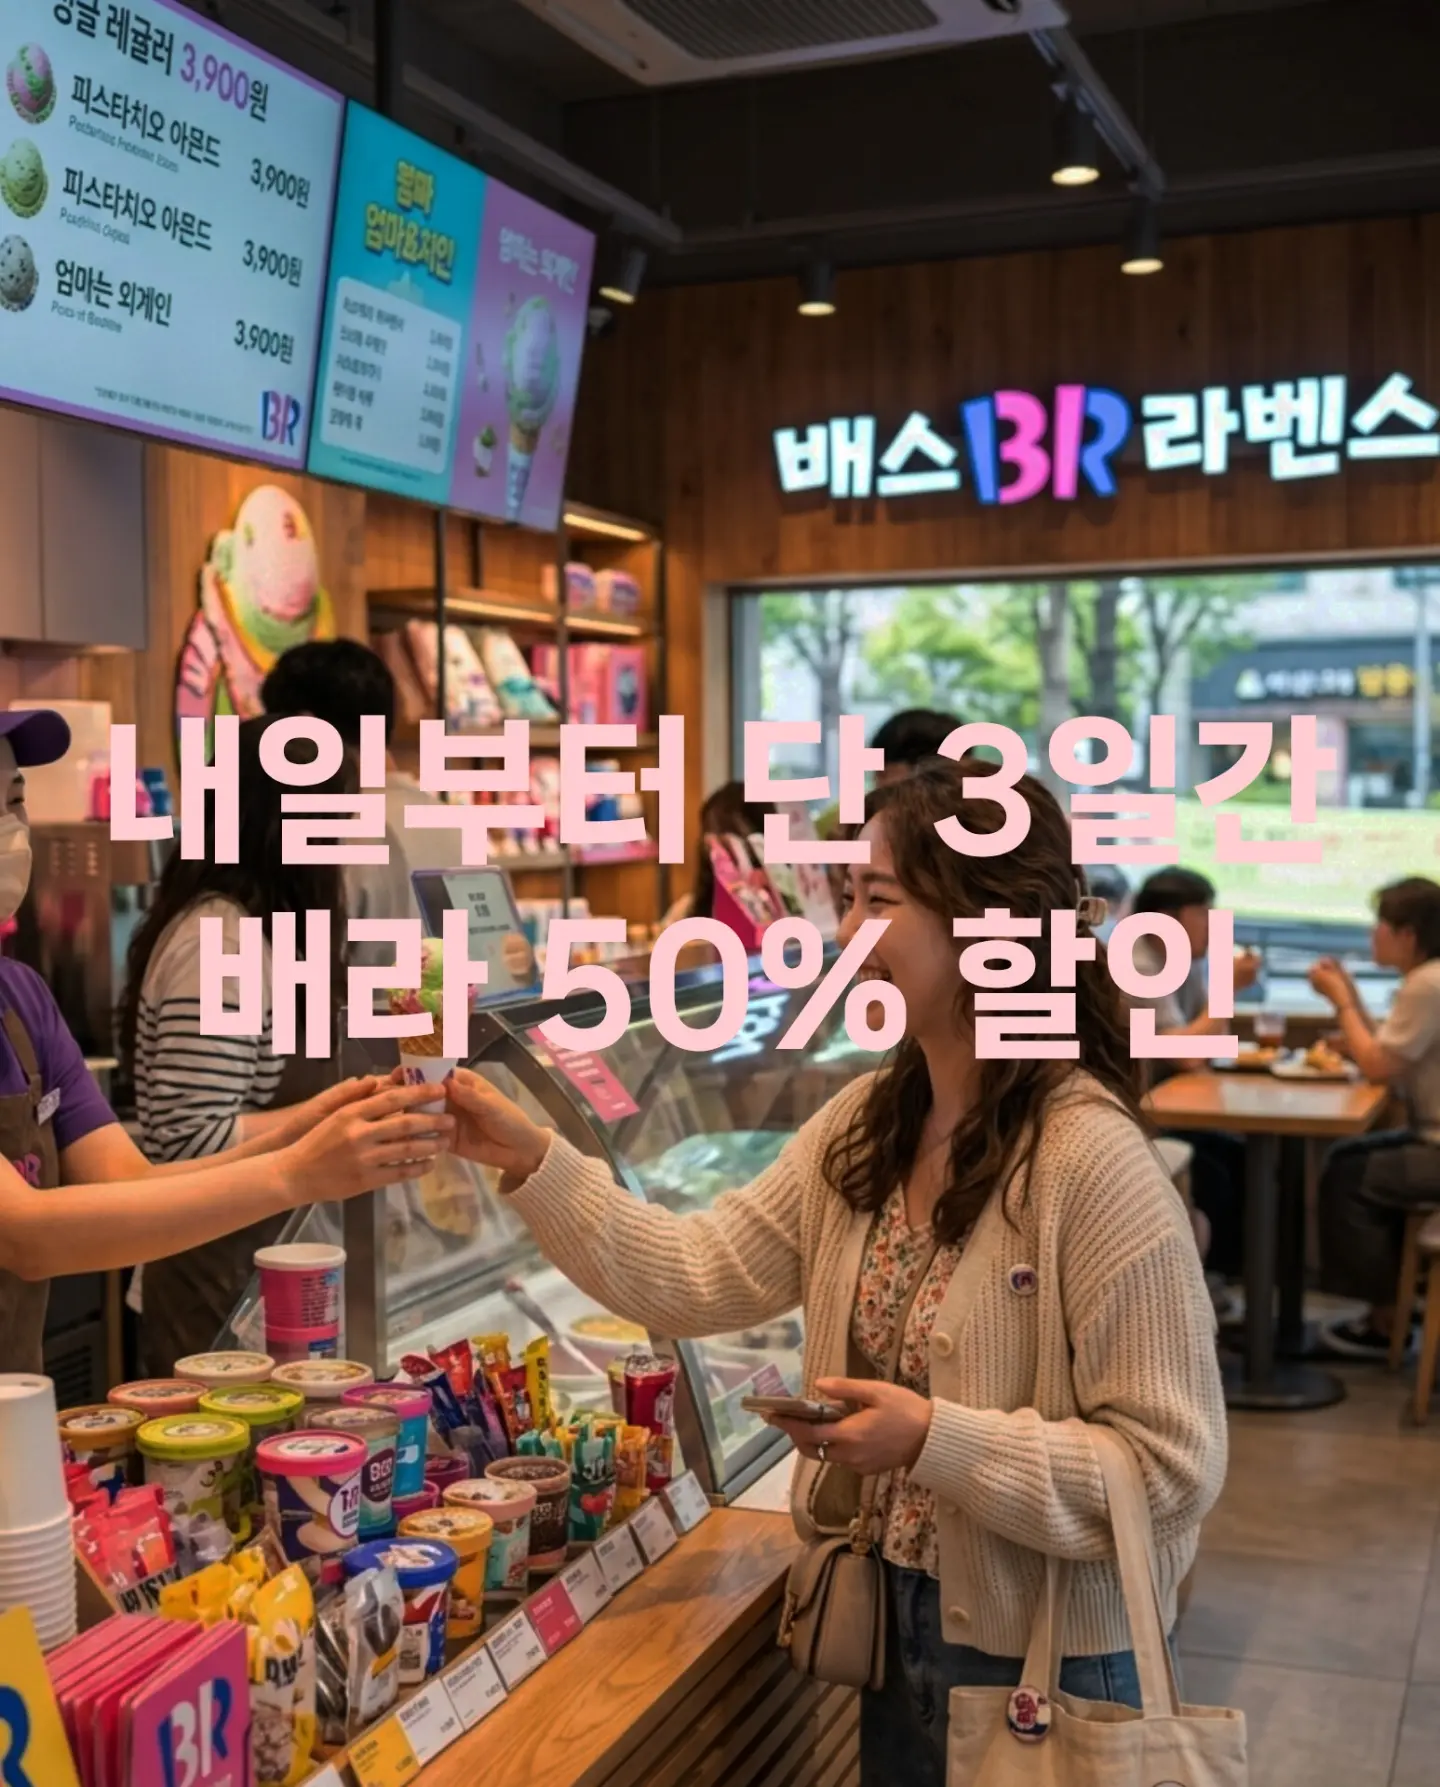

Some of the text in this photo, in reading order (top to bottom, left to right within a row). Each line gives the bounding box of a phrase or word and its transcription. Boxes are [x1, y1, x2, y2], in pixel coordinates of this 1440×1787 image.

[106, 3, 175, 77] 레귤러
[180, 41, 269, 123] 3,900원
[71, 74, 165, 143] 피스타치오
[55, 258, 114, 310] 엄마는
[117, 280, 173, 328] 외계인
[261, 389, 302, 447] BR
[774, 371, 1440, 506] 배스 BR 라벤스
